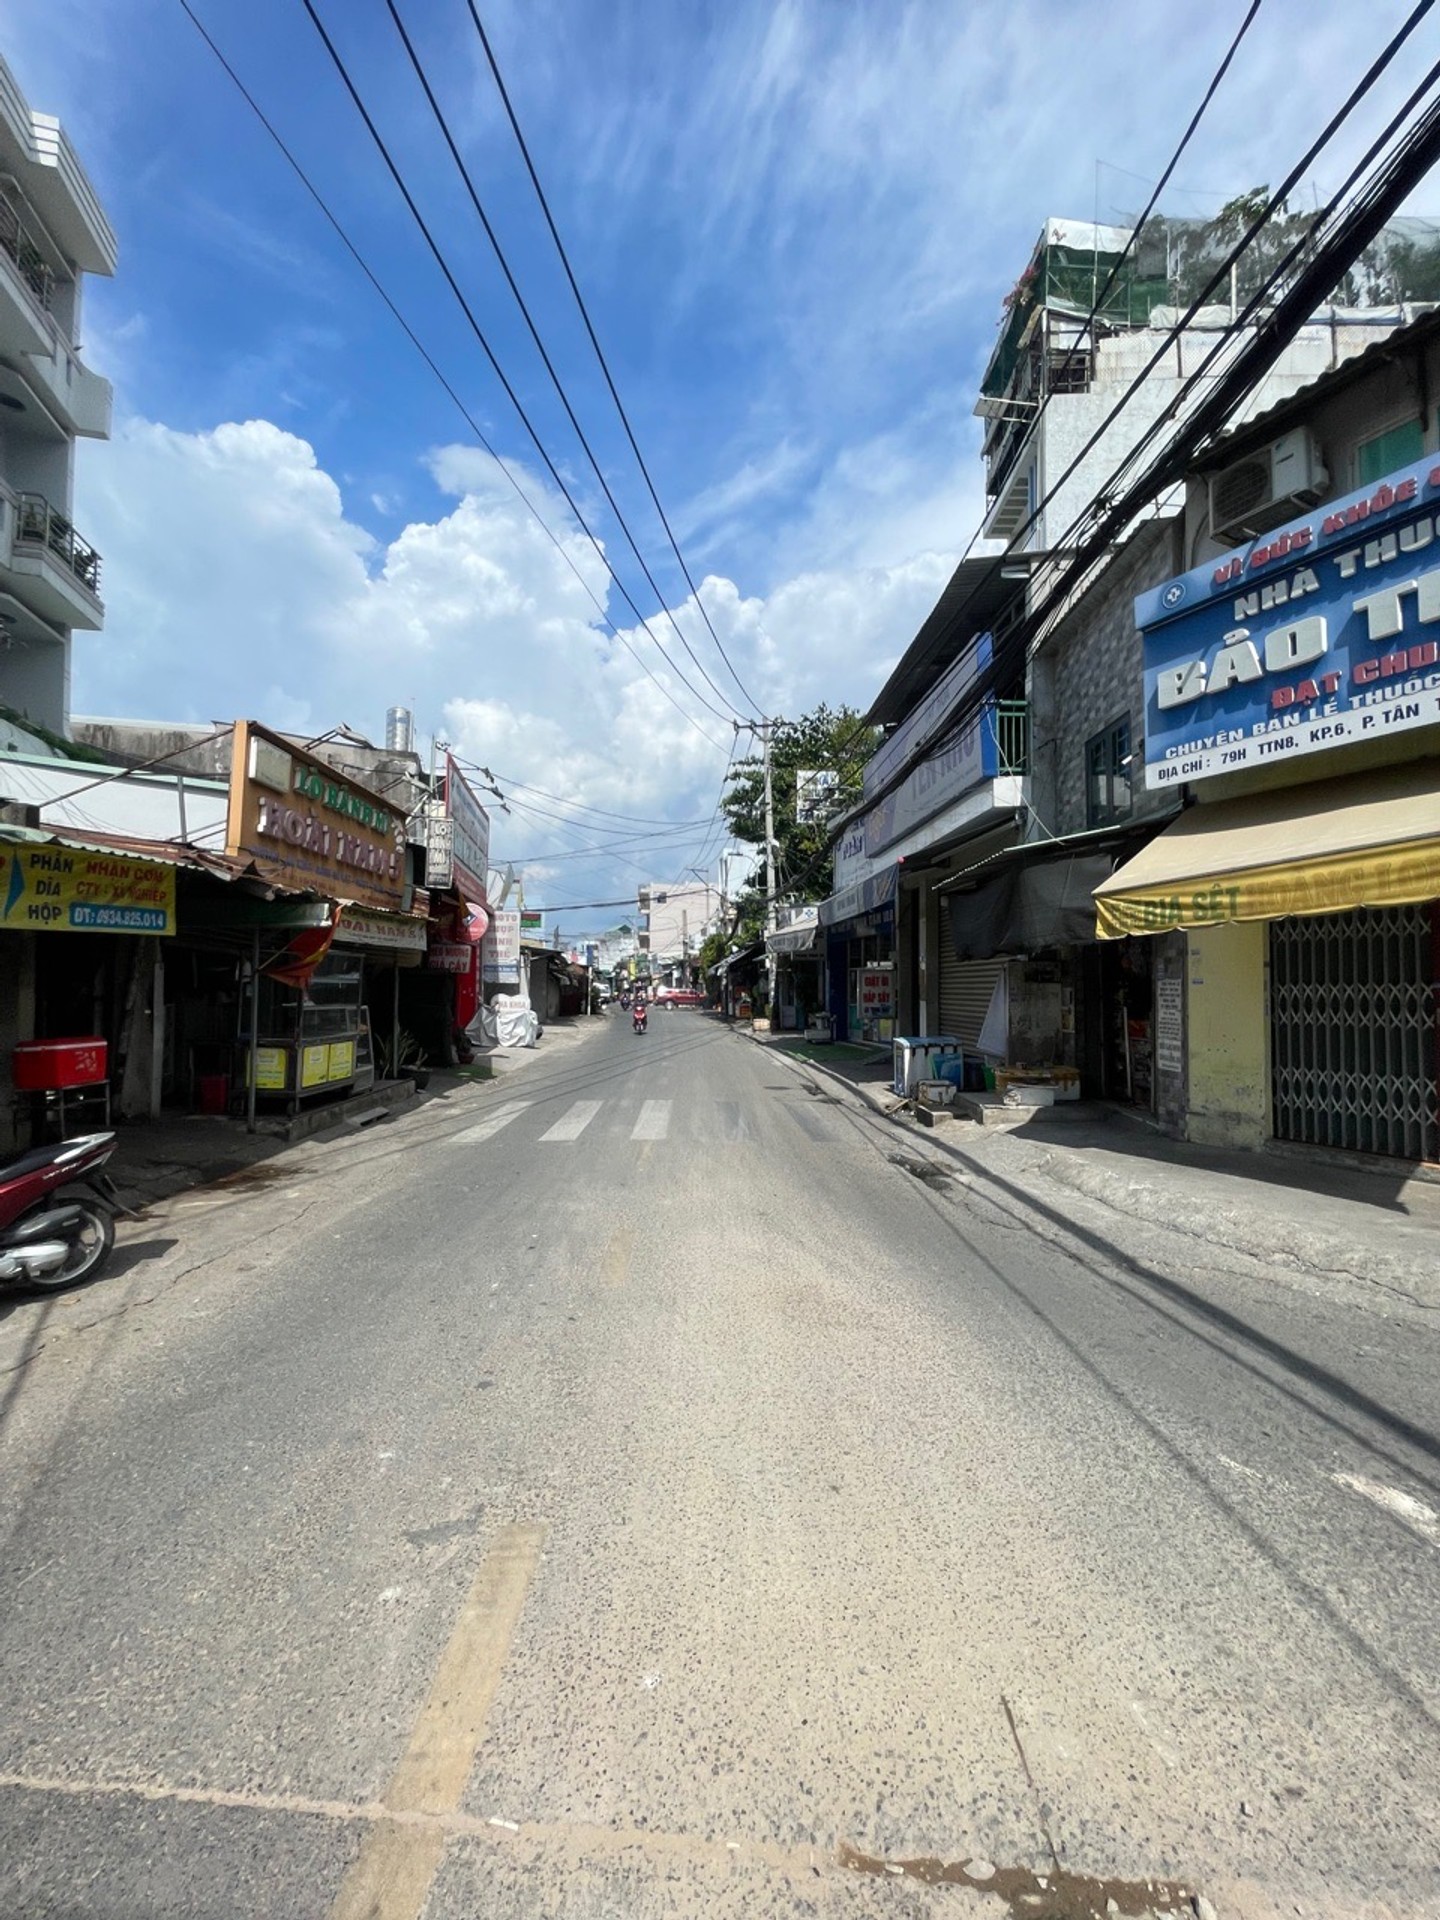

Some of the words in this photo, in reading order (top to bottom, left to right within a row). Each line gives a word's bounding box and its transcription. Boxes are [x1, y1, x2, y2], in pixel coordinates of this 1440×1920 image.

[1234, 567, 1320, 621] NHÀ
[1334, 516, 1440, 578] THU
[1158, 616, 1328, 710] BẢO
[1271, 670, 1342, 709] ĐẠT
[1352, 641, 1440, 684] CHU
[1158, 766, 1179, 781] ĐỊA
[1221, 748, 1247, 765] 79H
[1362, 715, 1376, 730] P.
[1382, 703, 1420, 723] TÂN
[1166, 729, 1244, 760] CHUYÊN
[1253, 713, 1300, 737] BÁN
[257, 796, 333, 857] HOÀI
[28, 901, 63, 925] HỘP
